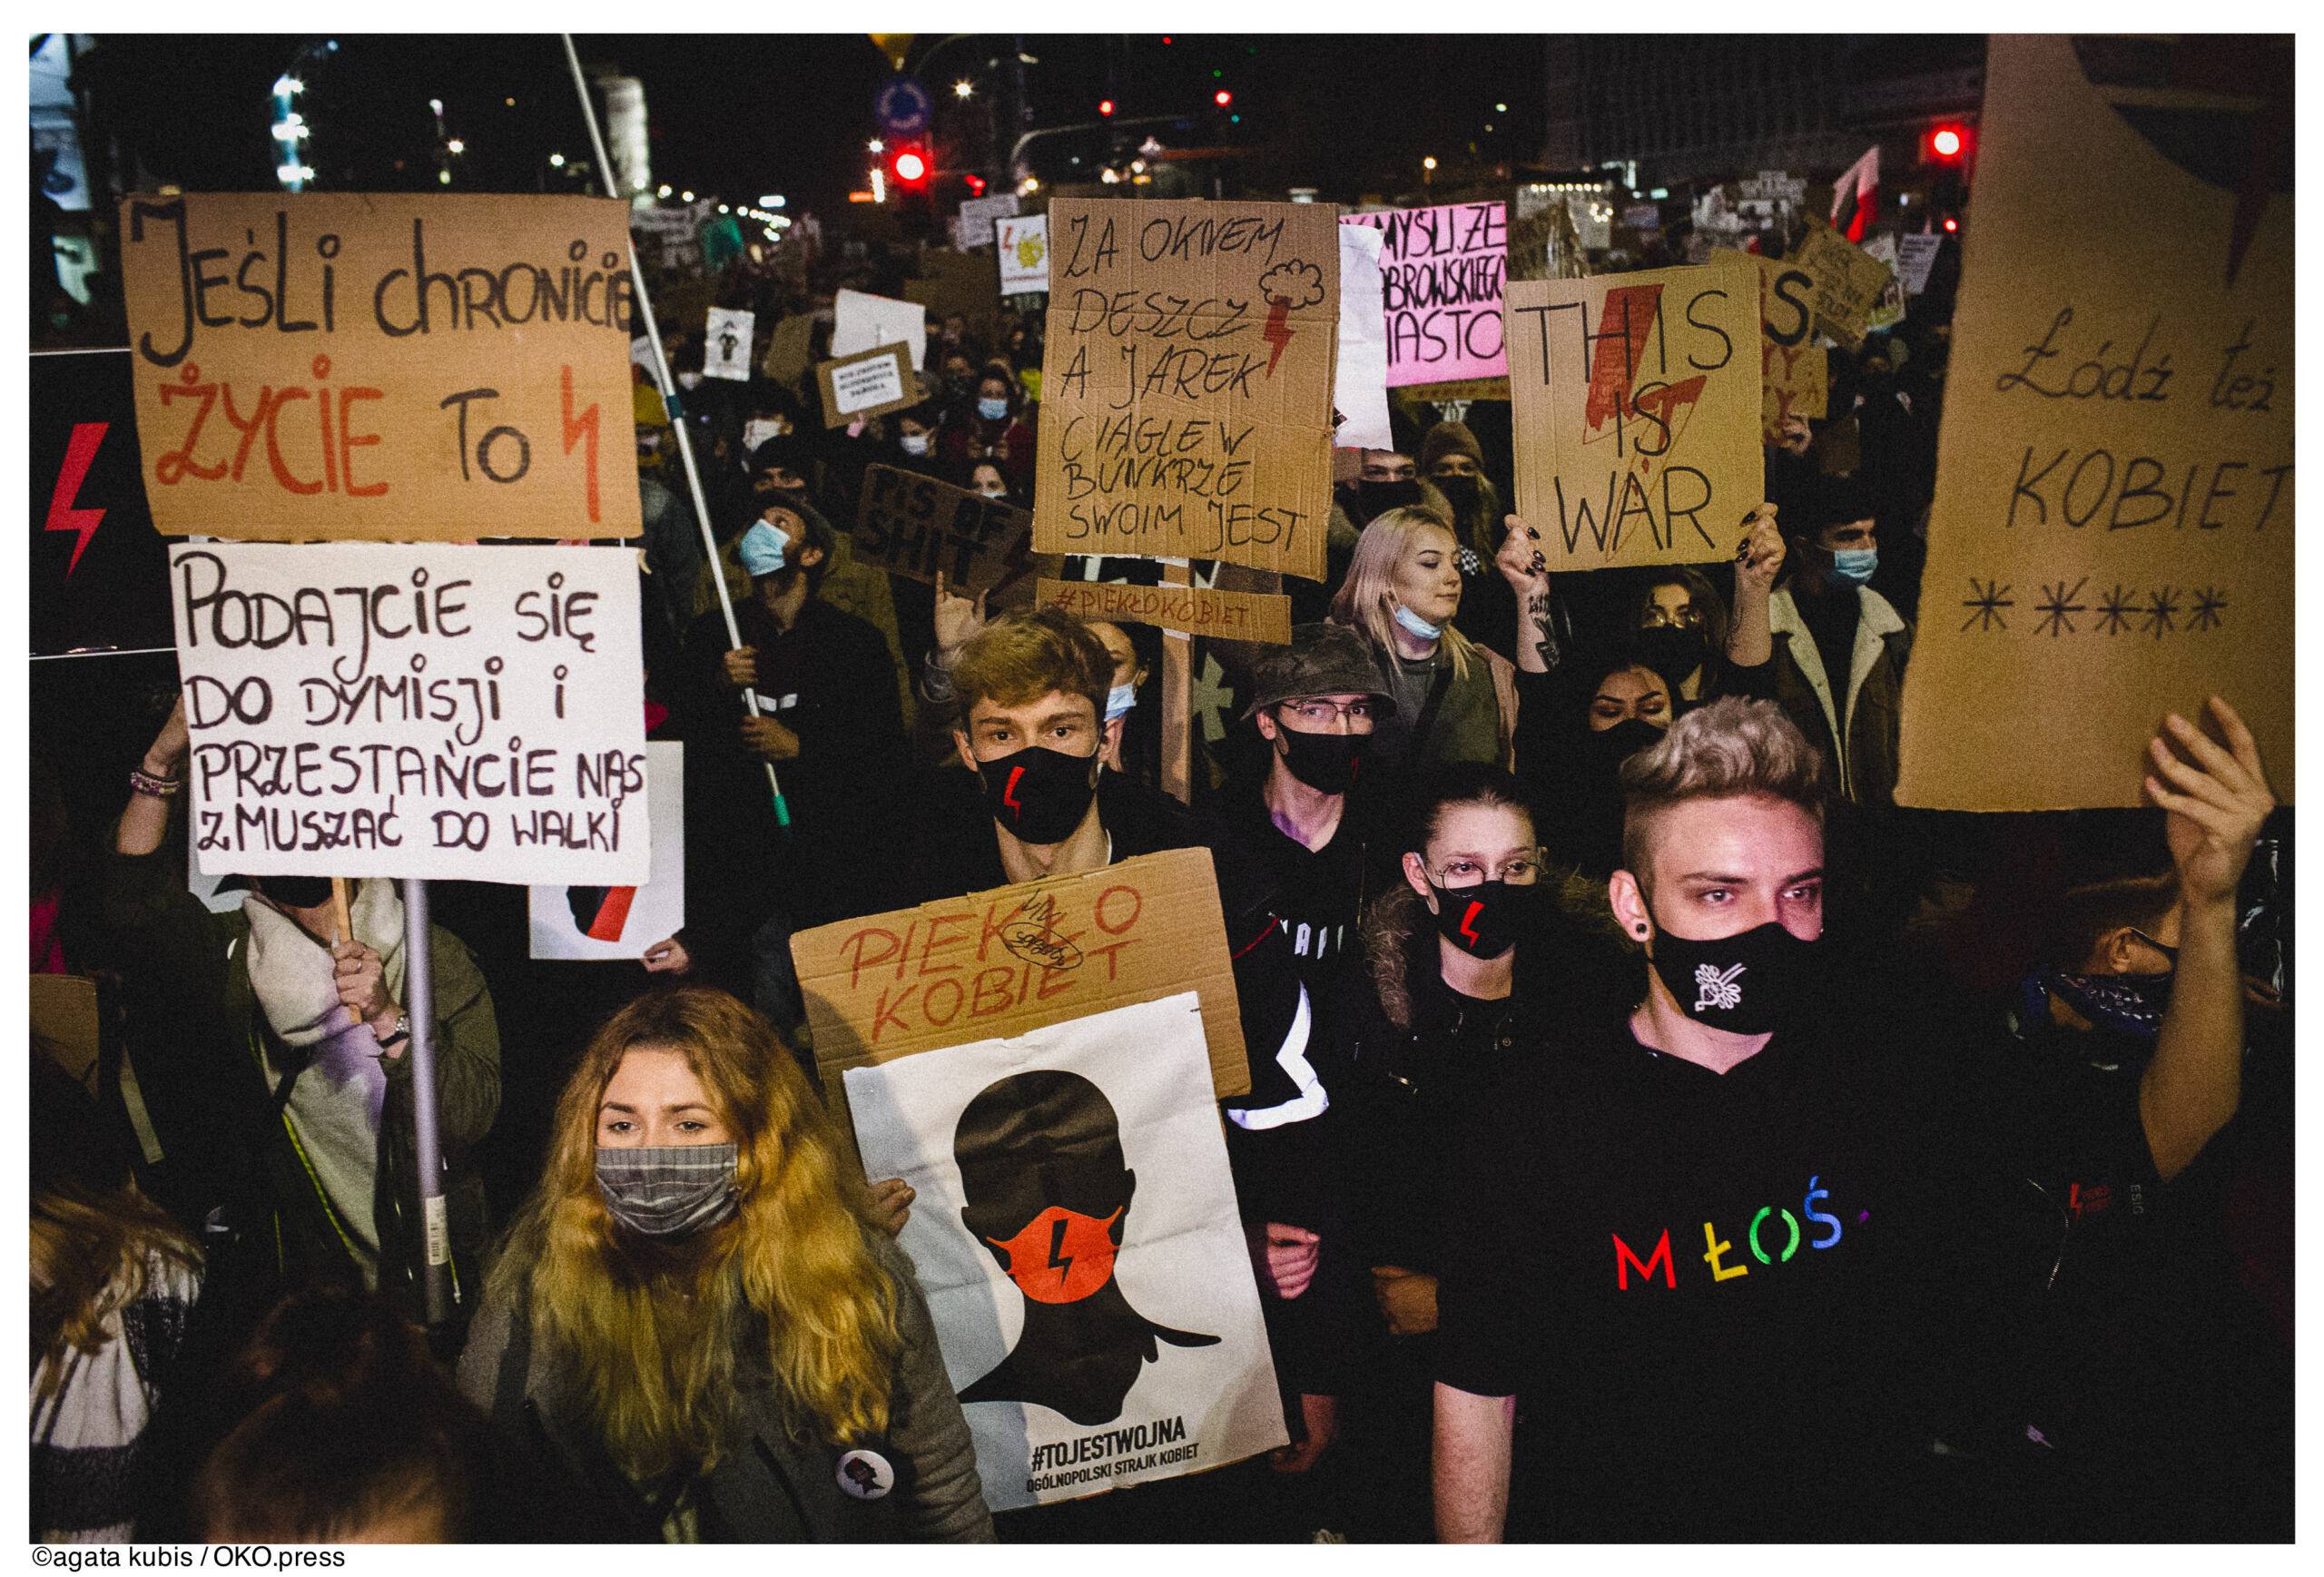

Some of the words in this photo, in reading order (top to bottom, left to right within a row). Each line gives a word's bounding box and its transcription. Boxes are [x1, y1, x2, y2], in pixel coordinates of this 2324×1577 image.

[1063, 216, 1119, 278] ZA
[1140, 216, 1285, 263] OKNEM
[1069, 289, 1251, 339] DESZCZ
[1386, 309, 1504, 368] IASTO
[1514, 290, 1733, 385] THIS
[1060, 345, 1088, 399] A
[1109, 344, 1267, 409] JAREK
[1998, 306, 2174, 402] Łódź
[1219, 421, 1256, 457] W
[1614, 382, 1672, 458] IS
[1063, 458, 1252, 500] BUNKRZE
[1553, 465, 1716, 554] WAR
[2005, 446, 2295, 532] KOBIET
[859, 507, 990, 586] SHIT
[1067, 503, 1184, 539] SWOIM
[1206, 499, 1308, 553] JEST
[184, 675, 271, 729] DO
[196, 793, 403, 852] ZMUSZAĆ
[432, 809, 490, 850] DO
[840, 884, 1143, 990] PIEKŁO
[871, 939, 1143, 1045] KOBIET
[1026, 1464, 1112, 1493] OGÓLNOPOLSKI
[1115, 1453, 1157, 1475] STRAJK
[1159, 1443, 1200, 1465] KOBIET
[1031, 1414, 1187, 1472] #TOJESTWOJNA
